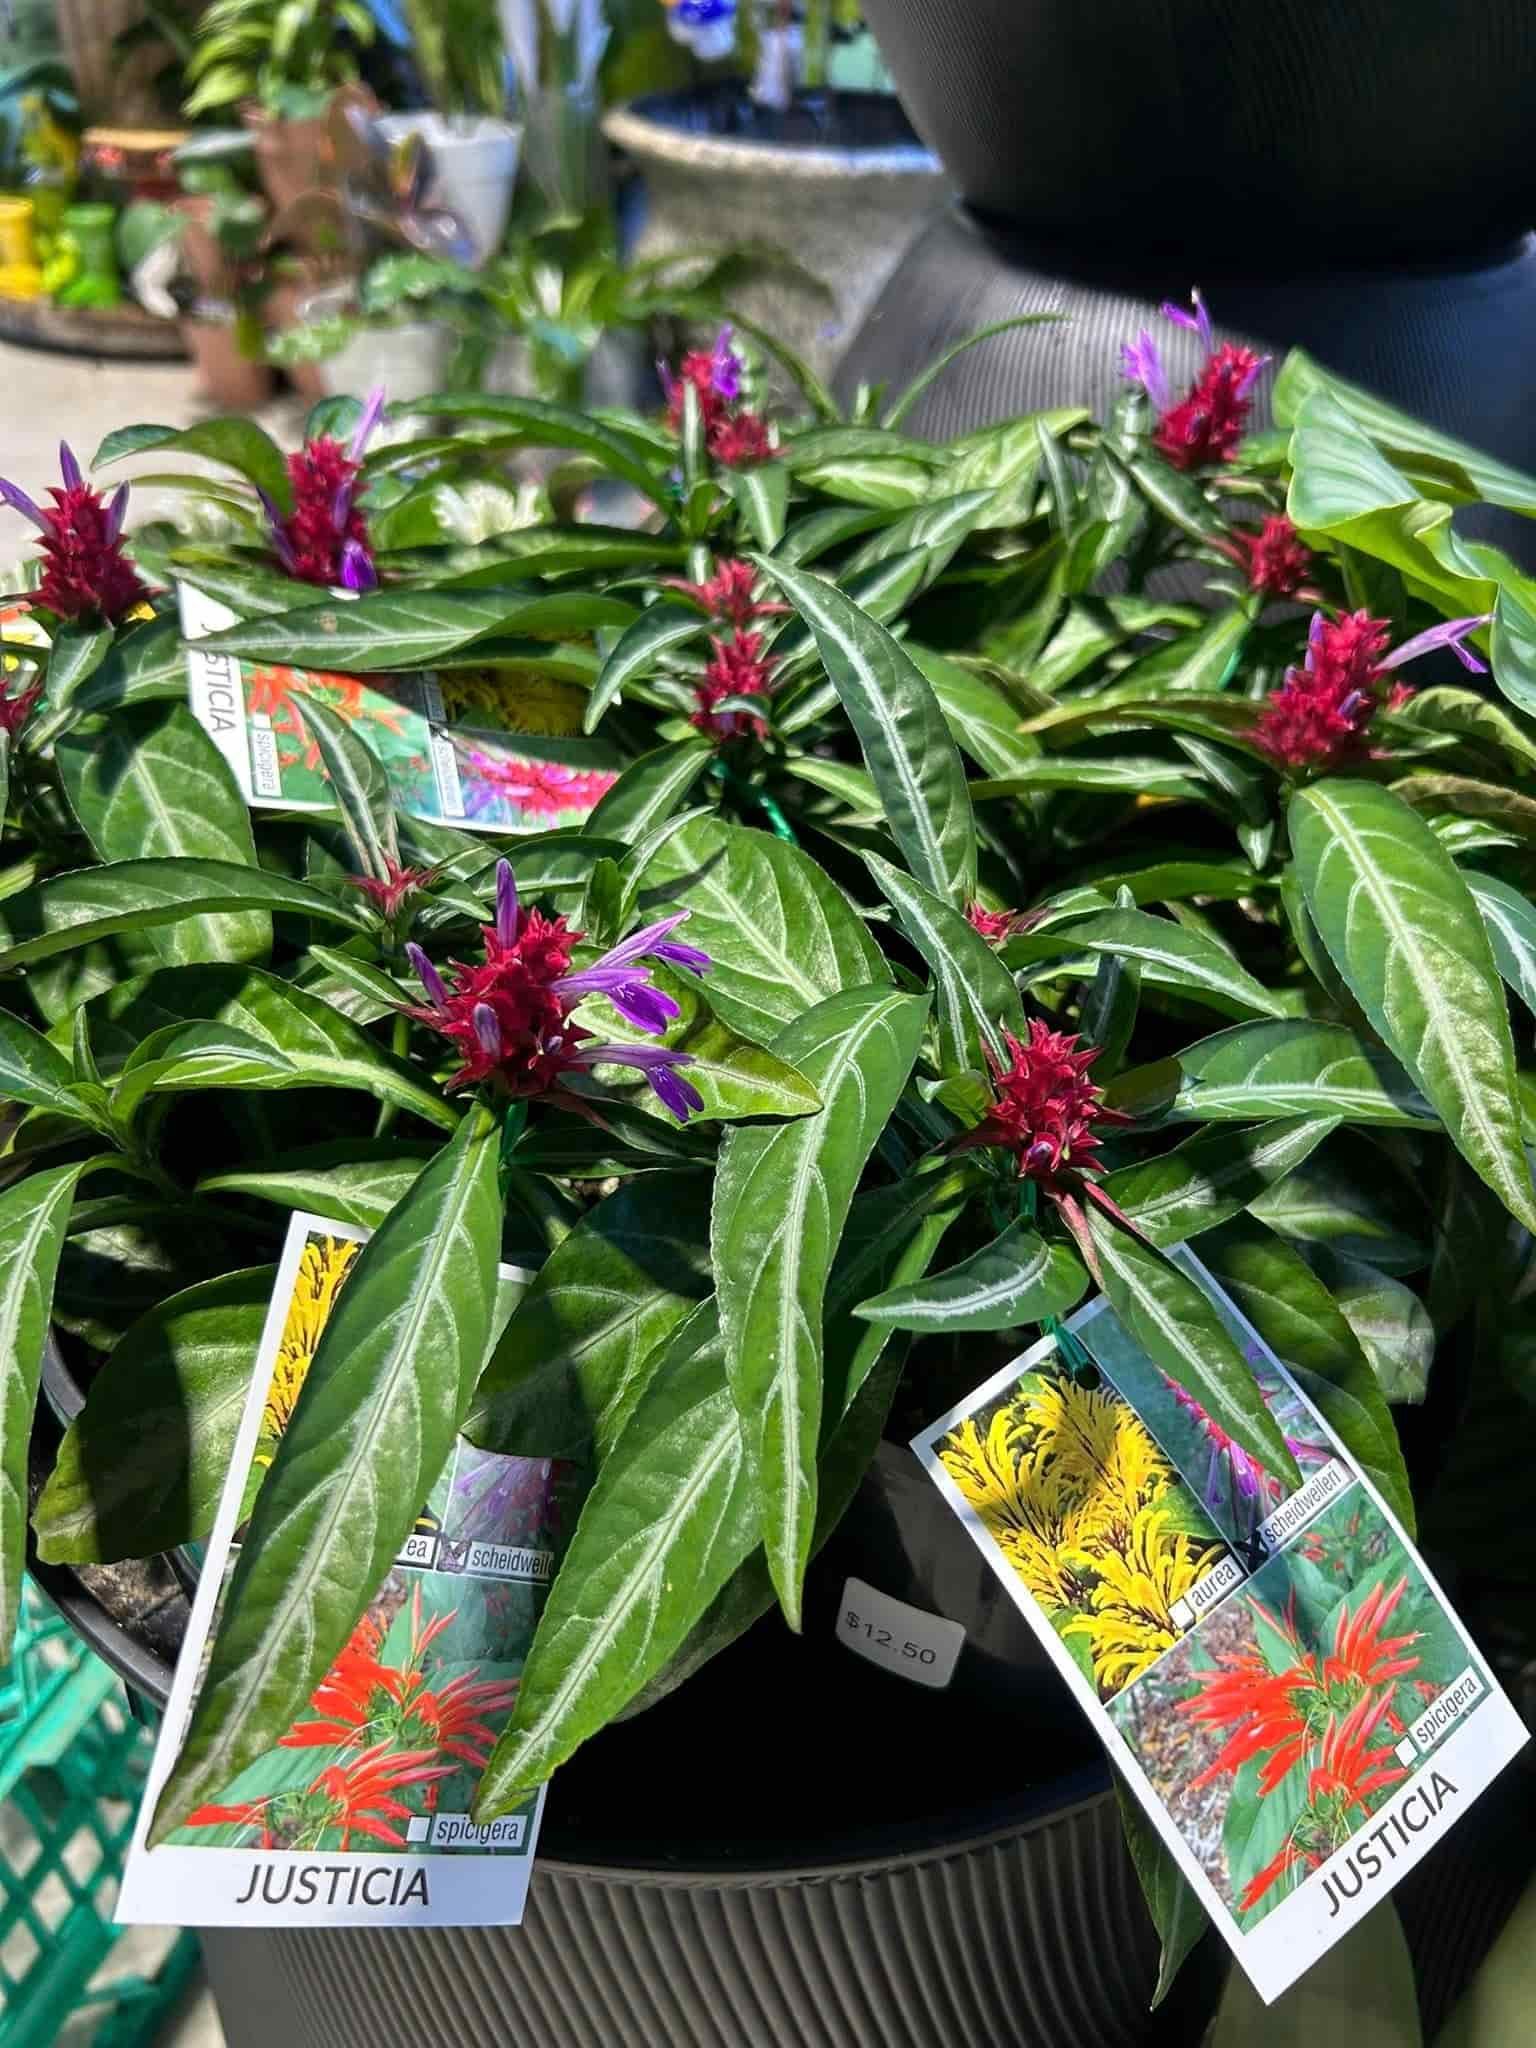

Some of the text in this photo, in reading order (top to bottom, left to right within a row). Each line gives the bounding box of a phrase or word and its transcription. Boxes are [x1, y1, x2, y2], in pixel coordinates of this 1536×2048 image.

[1264, 1465, 1342, 1544] scheidweileri
[1193, 1562, 1236, 1607] aurea
[845, 1611, 936, 1665] $12.50
[1416, 1676, 1477, 1743] spicigera
[437, 1816, 519, 1845] spicigera
[1321, 1771, 1459, 1917] JUSTICIA
[236, 1863, 430, 1907] JUSTICIA
